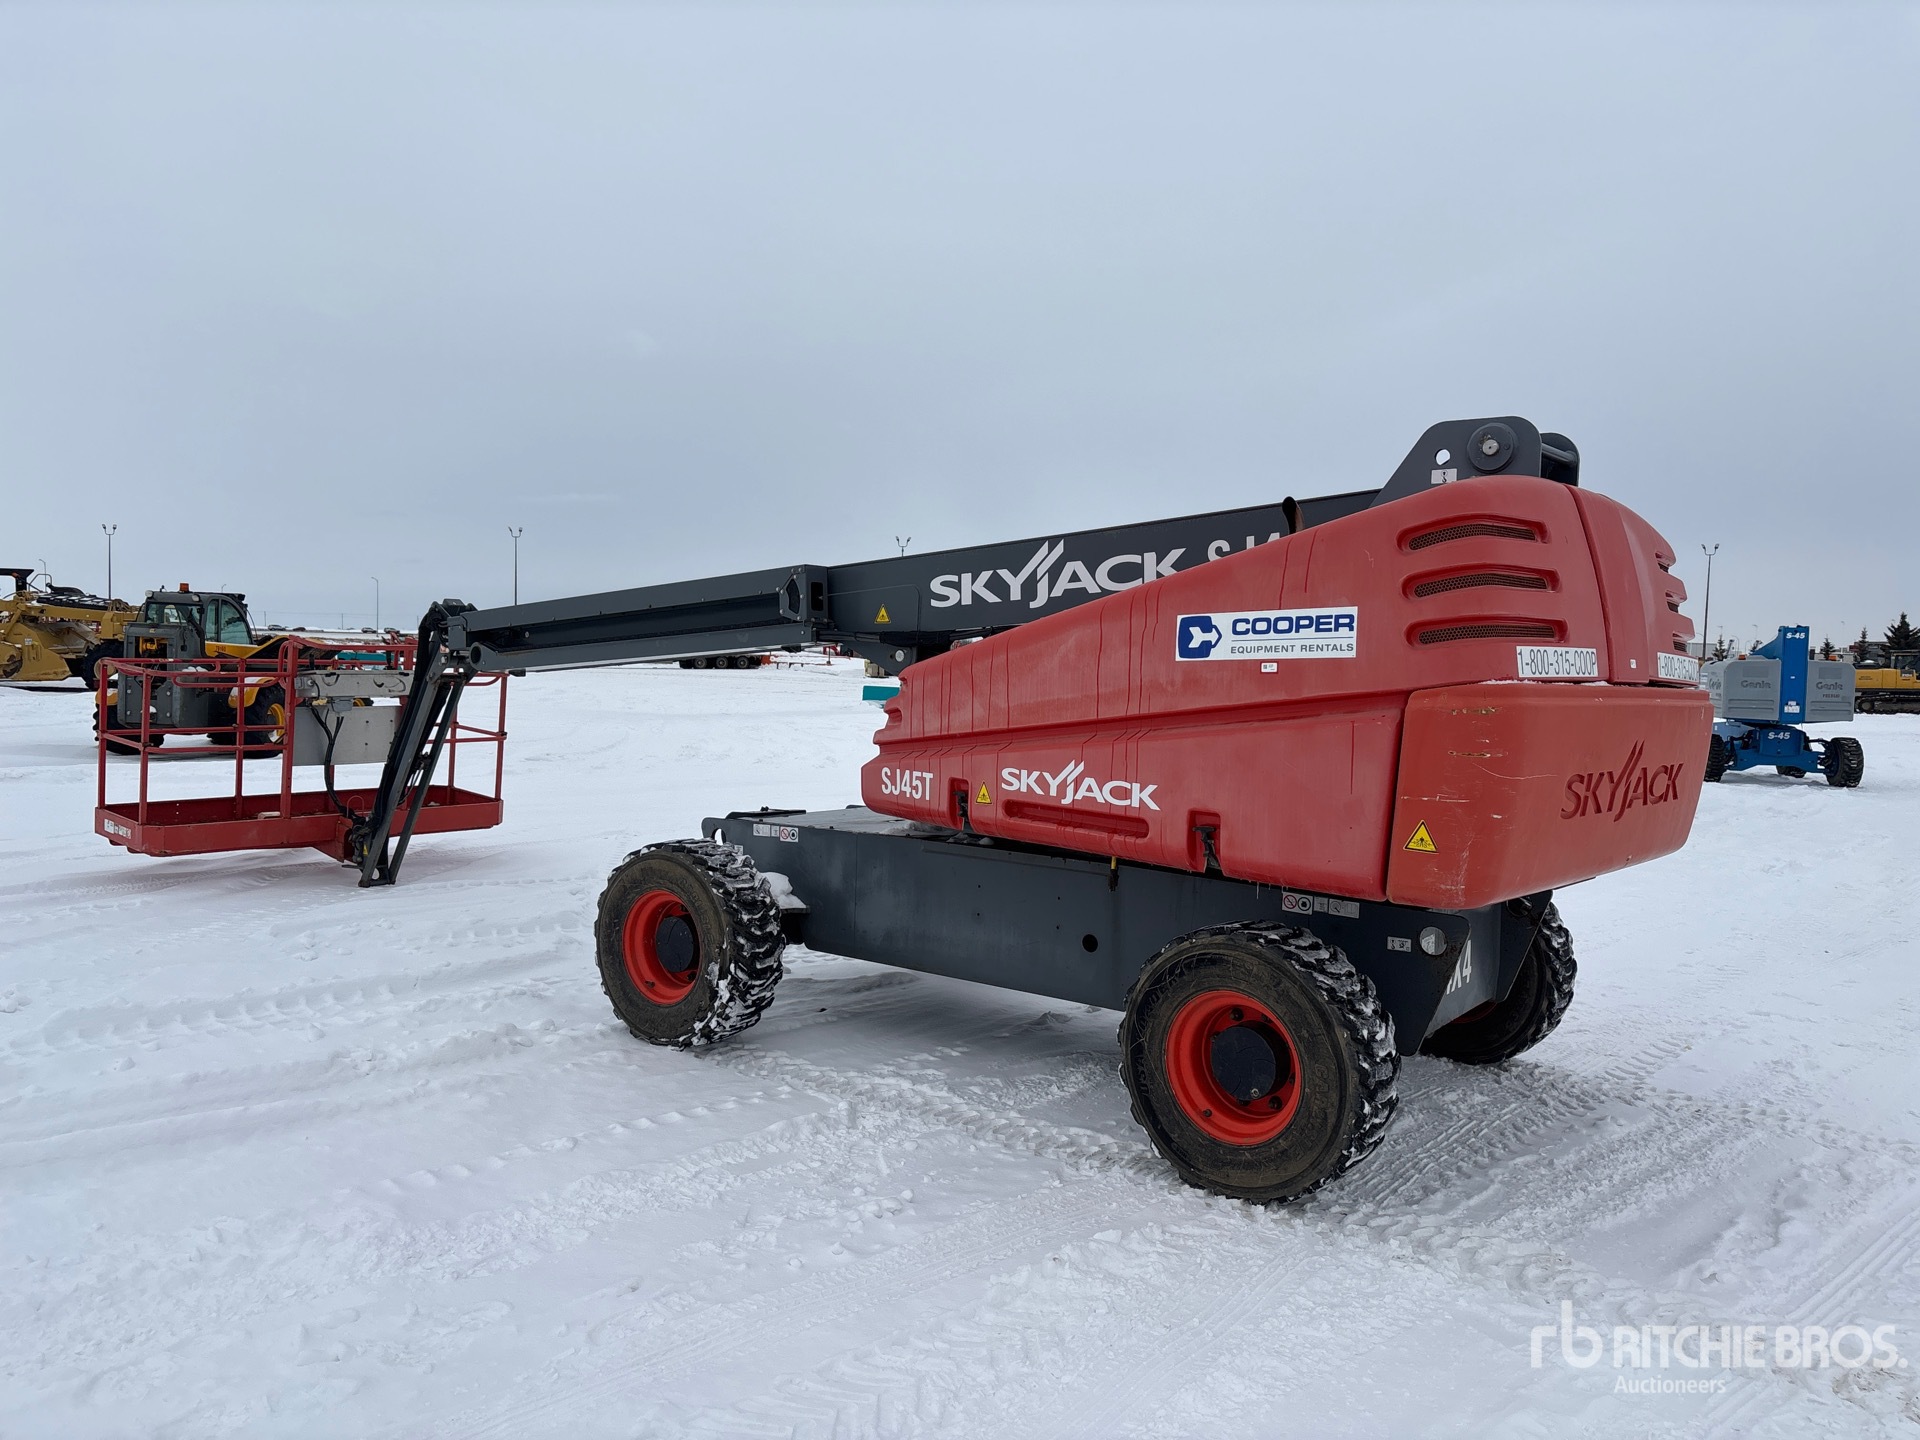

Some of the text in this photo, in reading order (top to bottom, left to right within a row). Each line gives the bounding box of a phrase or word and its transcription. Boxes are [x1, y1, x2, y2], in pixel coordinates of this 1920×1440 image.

[930, 539, 1187, 608] SKYJACK
[1231, 614, 1355, 636] COOPER
[1786, 632, 1806, 640] S-45
[1230, 643, 1354, 654] EQUIPMENT RENTALS
[1518, 648, 1596, 676] 1-800-315-COOP
[1741, 680, 1772, 689] Genie
[1816, 682, 1843, 691] Genie
[1768, 732, 1791, 740] S-45
[881, 767, 933, 801] SJ45T
[1001, 760, 1160, 811] SKYJACK
[1560, 740, 1684, 822] SKYJACK
[1446, 939, 1472, 995] X4
